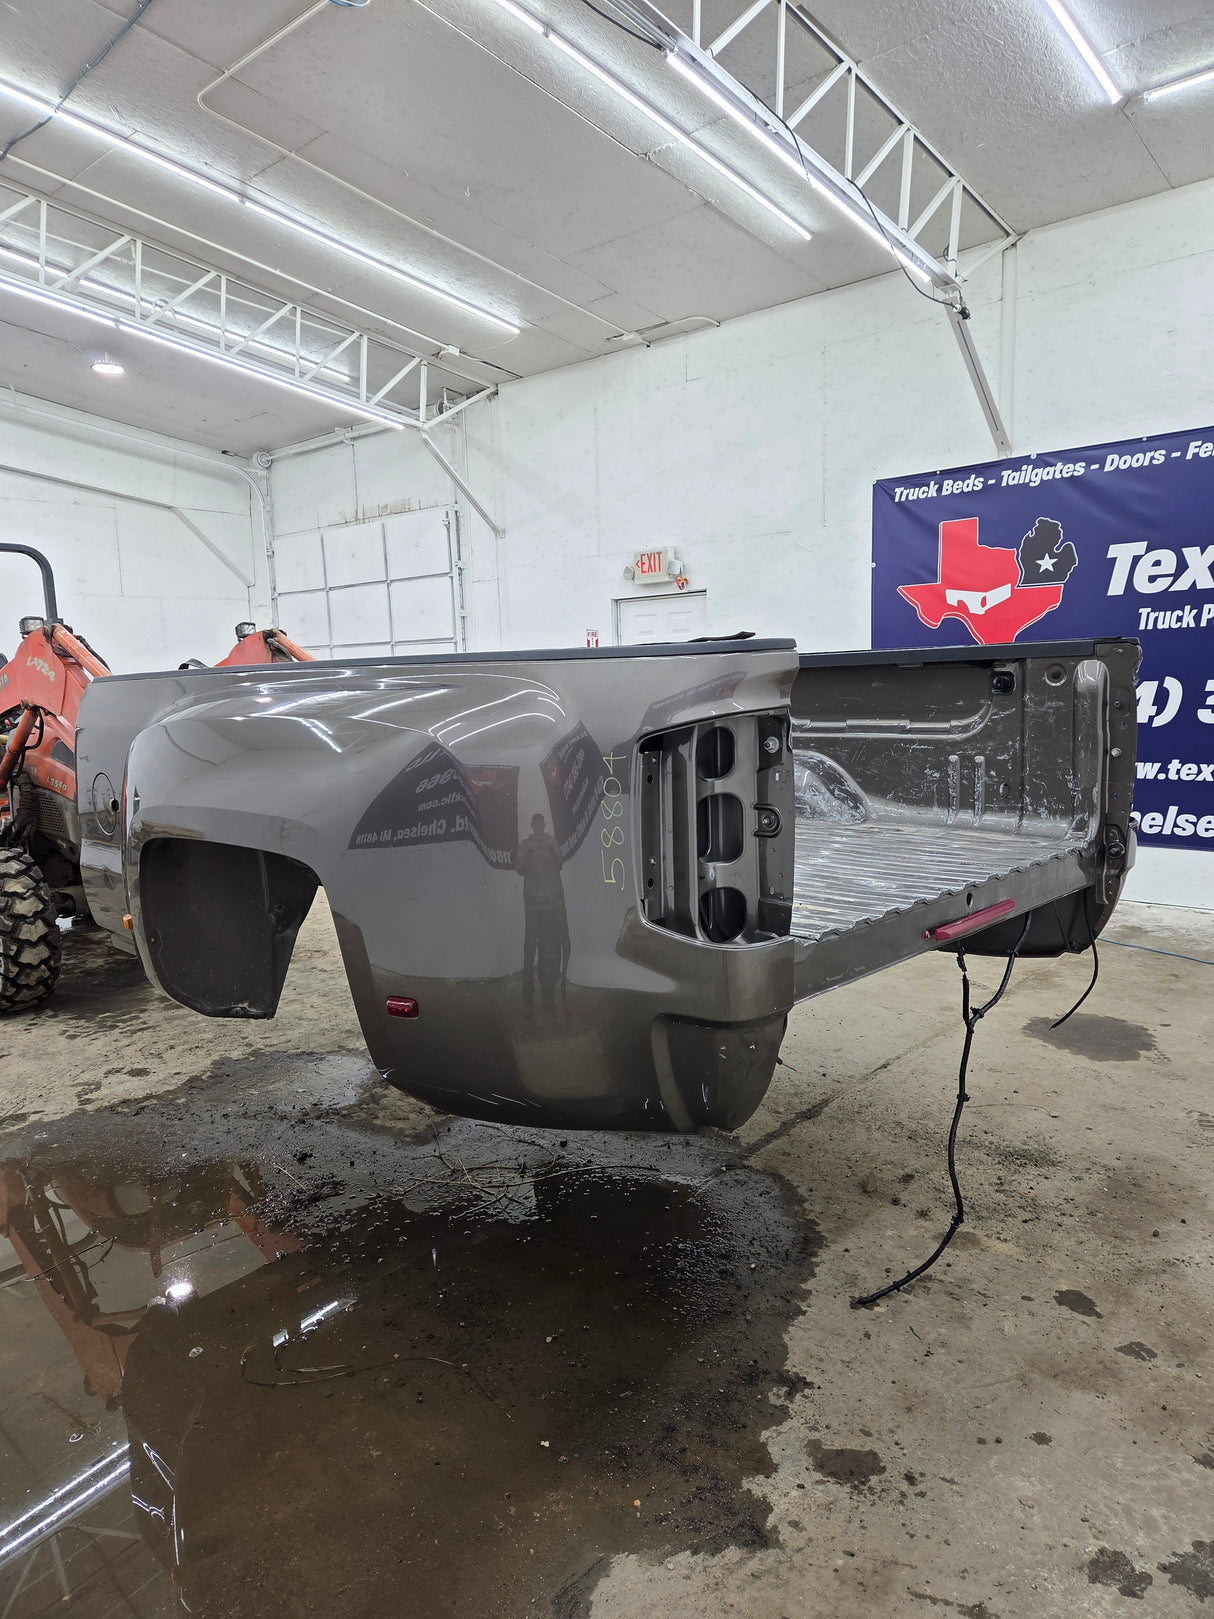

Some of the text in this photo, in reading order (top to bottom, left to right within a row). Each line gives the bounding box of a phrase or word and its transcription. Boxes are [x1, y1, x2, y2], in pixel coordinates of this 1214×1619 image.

[894, 481, 939, 503] Truck
[941, 474, 984, 496] Beds
[1001, 461, 1086, 487] Tailgates
[1103, 449, 1167, 472] Doors
[1185, 440, 1214, 461] Fe
[640, 551, 662, 574] EXIT
[1138, 603, 1214, 631] Truck P
[1135, 759, 1214, 782] w.tex
[600, 752, 626, 891] 58804
